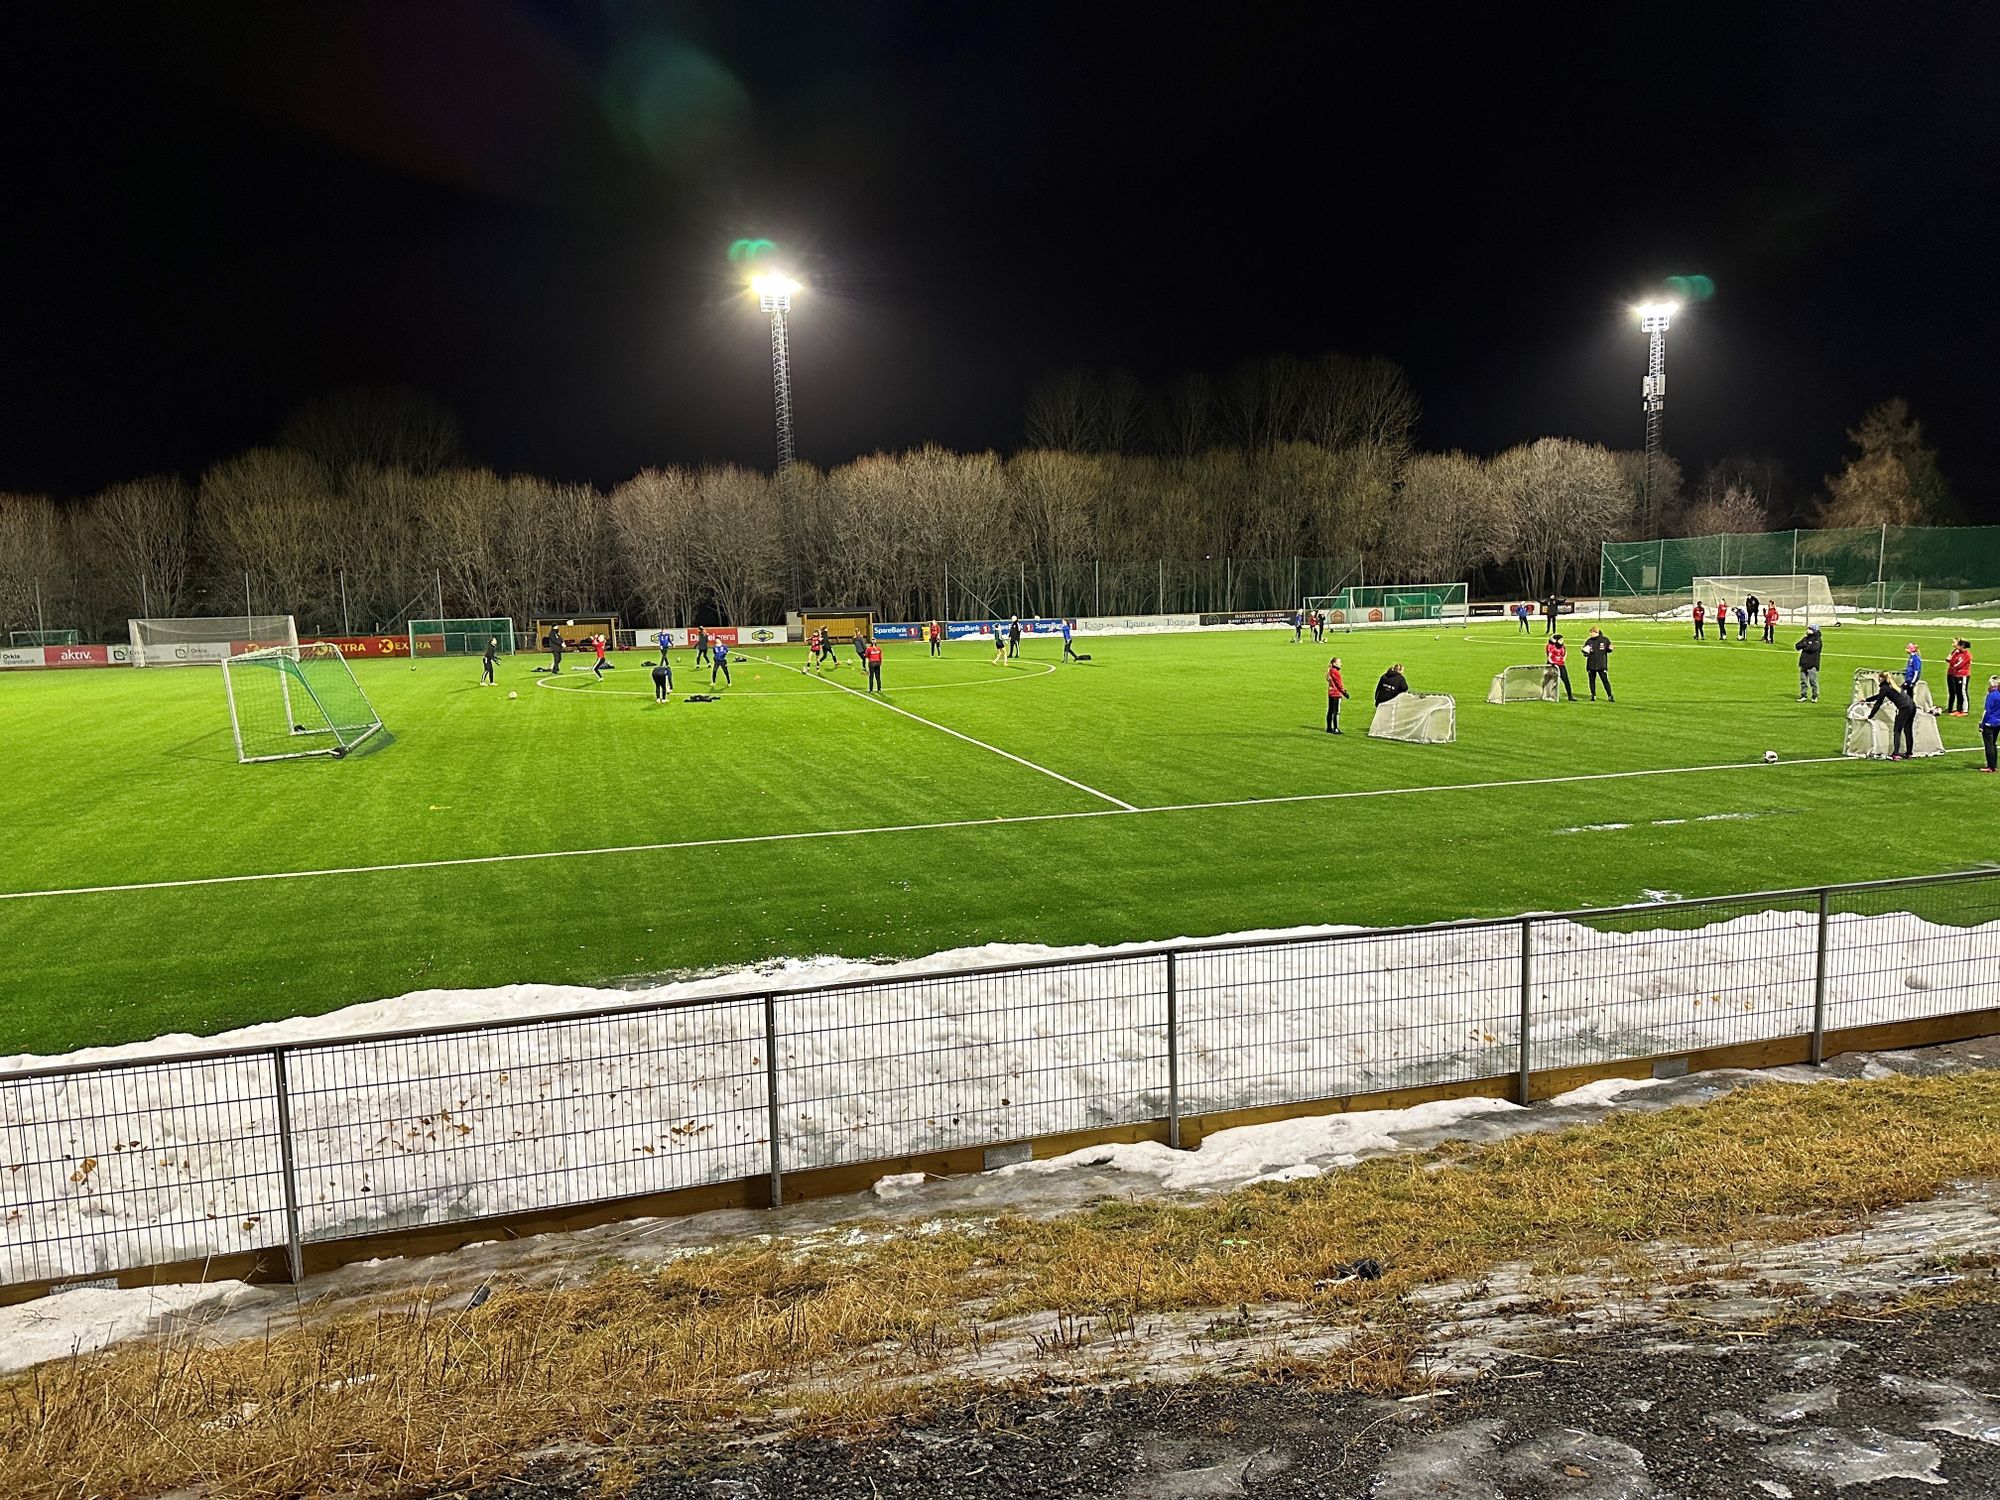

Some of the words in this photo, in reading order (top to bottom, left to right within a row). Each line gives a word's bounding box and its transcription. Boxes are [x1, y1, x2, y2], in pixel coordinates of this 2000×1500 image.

[873, 626, 908, 635] SpareBank
[947, 625, 981, 633] SpareBank
[394, 641, 432, 650] EXRA
